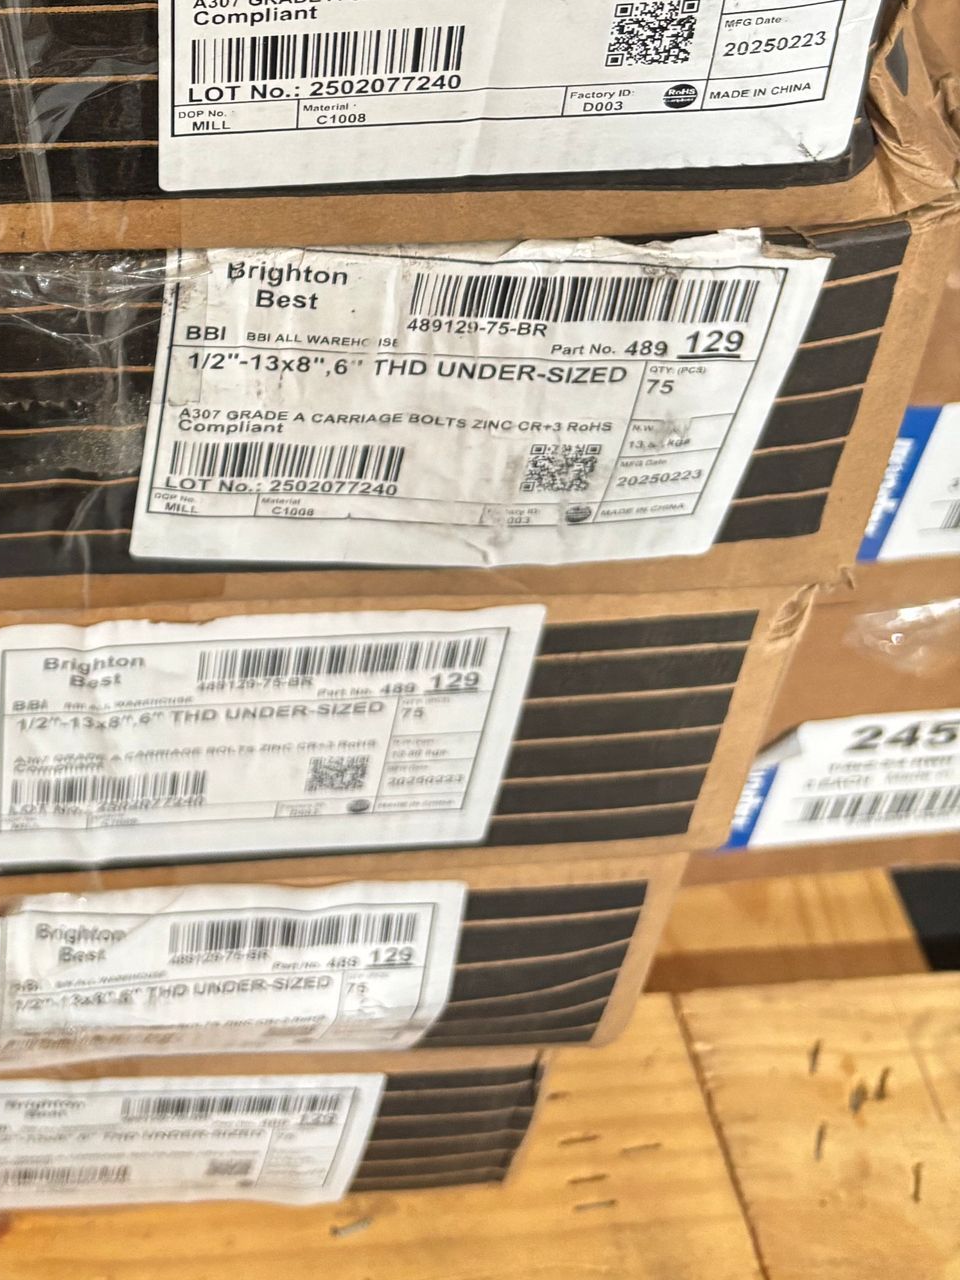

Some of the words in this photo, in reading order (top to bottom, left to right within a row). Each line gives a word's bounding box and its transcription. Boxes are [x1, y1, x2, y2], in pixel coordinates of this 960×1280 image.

[193, 5, 318, 27] Compliant
[724, 17, 752, 28] MFG
[755, 15, 782, 26] Date
[723, 31, 827, 57] 20250223
[188, 85, 241, 103] LOT
[251, 83, 301, 100] No.:
[309, 74, 462, 97] 2502077240
[570, 89, 615, 101] Factory
[667, 86, 696, 96] RoHS
[709, 89, 750, 100] MADE
[753, 87, 767, 98] IN
[771, 82, 812, 96] CHINA
[178, 110, 204, 120] DOP
[303, 102, 350, 113] Material
[582, 101, 623, 113] D003
[191, 120, 231, 132] MILL
[316, 113, 366, 126] C1008
[227, 261, 349, 287] Brighton
[255, 288, 319, 311] Best
[186, 326, 226, 341] BBI
[246, 331, 271, 343] BBI
[275, 332, 303, 343] ALL
[407, 318, 548, 338] 489129-75-BR
[550, 343, 585, 357] Part
[589, 343, 616, 356] No.
[624, 340, 669, 357] 489
[685, 329, 745, 354] 129
[374, 358, 427, 377] THD
[437, 360, 628, 384] UNDER-SIZED
[646, 379, 675, 395] 75
[178, 408, 221, 420] A307
[227, 410, 289, 421] GRADE
[293, 412, 305, 422] A
[311, 412, 403, 424] CARRIAGE
[408, 413, 467, 429] BOLTS
[471, 418, 513, 431] ZINC
[517, 420, 562, 433] CR+3
[566, 420, 613, 432] RoHS
[178, 418, 284, 436] Compliant
[164, 476, 212, 491] LOT
[269, 479, 399, 498] 2502077240
[616, 468, 703, 488] 20250223
[164, 502, 198, 514] MILL
[43, 656, 145, 676] Brighton
[69, 673, 122, 690] Best
[430, 671, 480, 690] 129
[171, 709, 218, 724] THD
[225, 701, 385, 721] UNDER-SIZED
[402, 706, 424, 720] 75
[371, 946, 415, 963] 129
[193, 975, 333, 997] UNDER-SIZED
